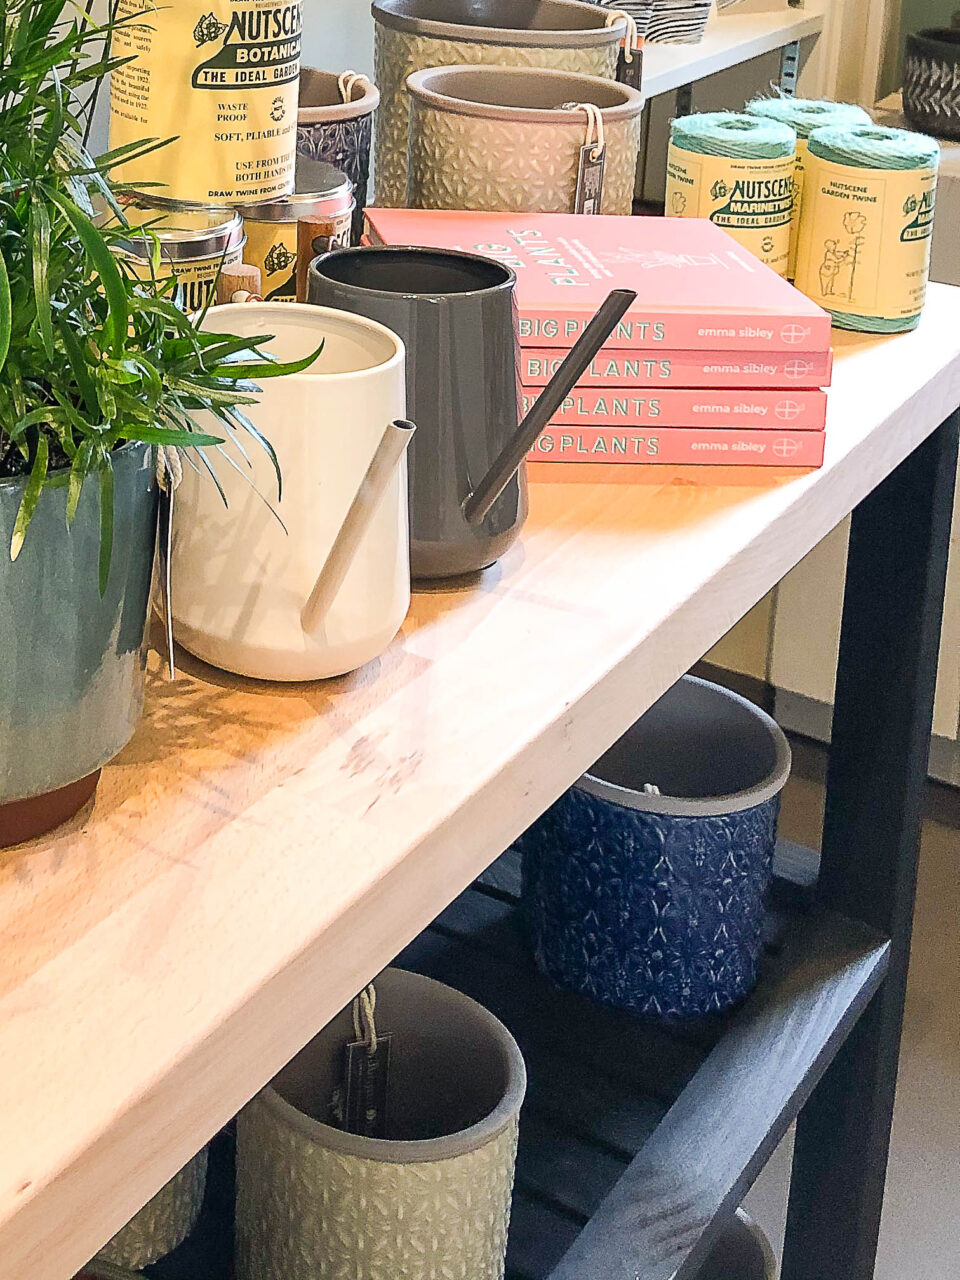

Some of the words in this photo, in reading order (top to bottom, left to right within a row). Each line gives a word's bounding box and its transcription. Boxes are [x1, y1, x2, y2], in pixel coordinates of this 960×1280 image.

[203, 70, 226, 83] THE
[235, 69, 268, 83] IDEAL
[273, 62, 298, 80] GARDEN
[217, 103, 248, 111] WASTE
[217, 113, 247, 122] PROOF
[214, 131, 244, 142] SOFT,
[246, 128, 281, 140] PLIABLE
[235, 161, 254, 171] USE
[256, 157, 279, 169] FROM
[235, 171, 261, 182] BOTH
[263, 167, 286, 180] HANDS
[235, 188, 258, 197] TWINE
[259, 186, 277, 195] FROM
[829, 180, 869, 193] NUTSCENE
[821, 187, 850, 201] GARDEN
[852, 194, 878, 203] TWINE
[716, 215, 732, 223] THE
[736, 216, 760, 225] IDEAL
[507, 228, 590, 287] PLANTS
[519, 319, 559, 337] BIG
[564, 319, 666, 341] PNTS
[697, 327, 736, 337] emma
[738, 326, 774, 340] sibley
[589, 359, 672, 379] LANTS
[703, 365, 740, 374] emma
[742, 363, 778, 375] sibley
[561, 397, 661, 418] PLANTS
[692, 404, 731, 413] emma
[733, 403, 769, 416] sibley
[560, 435, 660, 455] PLANTS
[691, 442, 729, 451] emma
[731, 440, 767, 453] sibley
